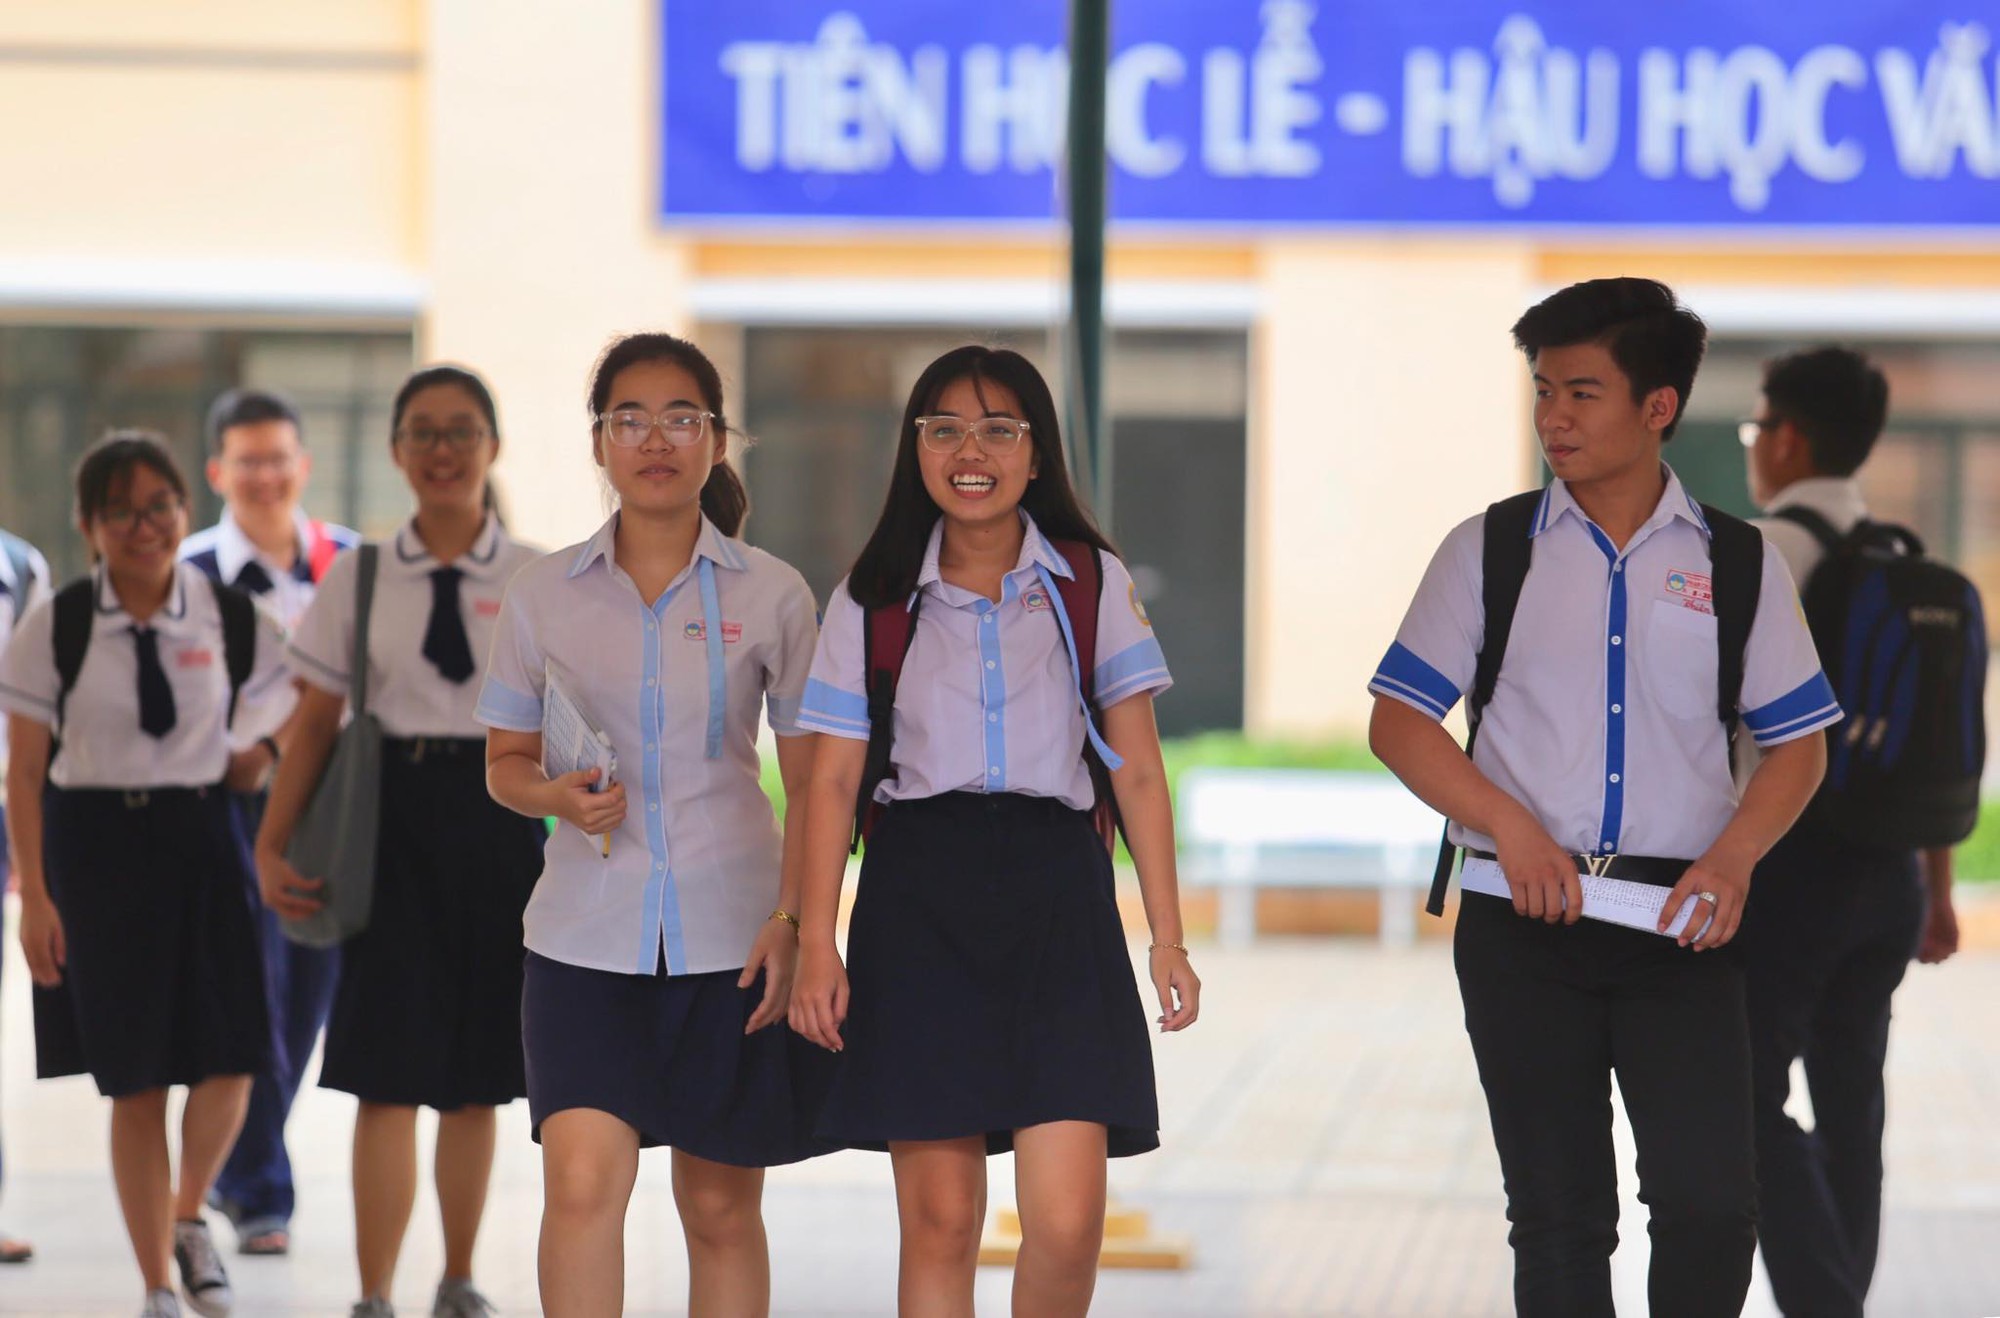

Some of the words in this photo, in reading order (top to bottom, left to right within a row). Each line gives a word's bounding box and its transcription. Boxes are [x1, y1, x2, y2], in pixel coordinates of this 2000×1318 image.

[1402, 15, 1620, 207] HẬU
[1636, 44, 1866, 211] HỌC
[1875, 22, 2000, 178] VĂ
